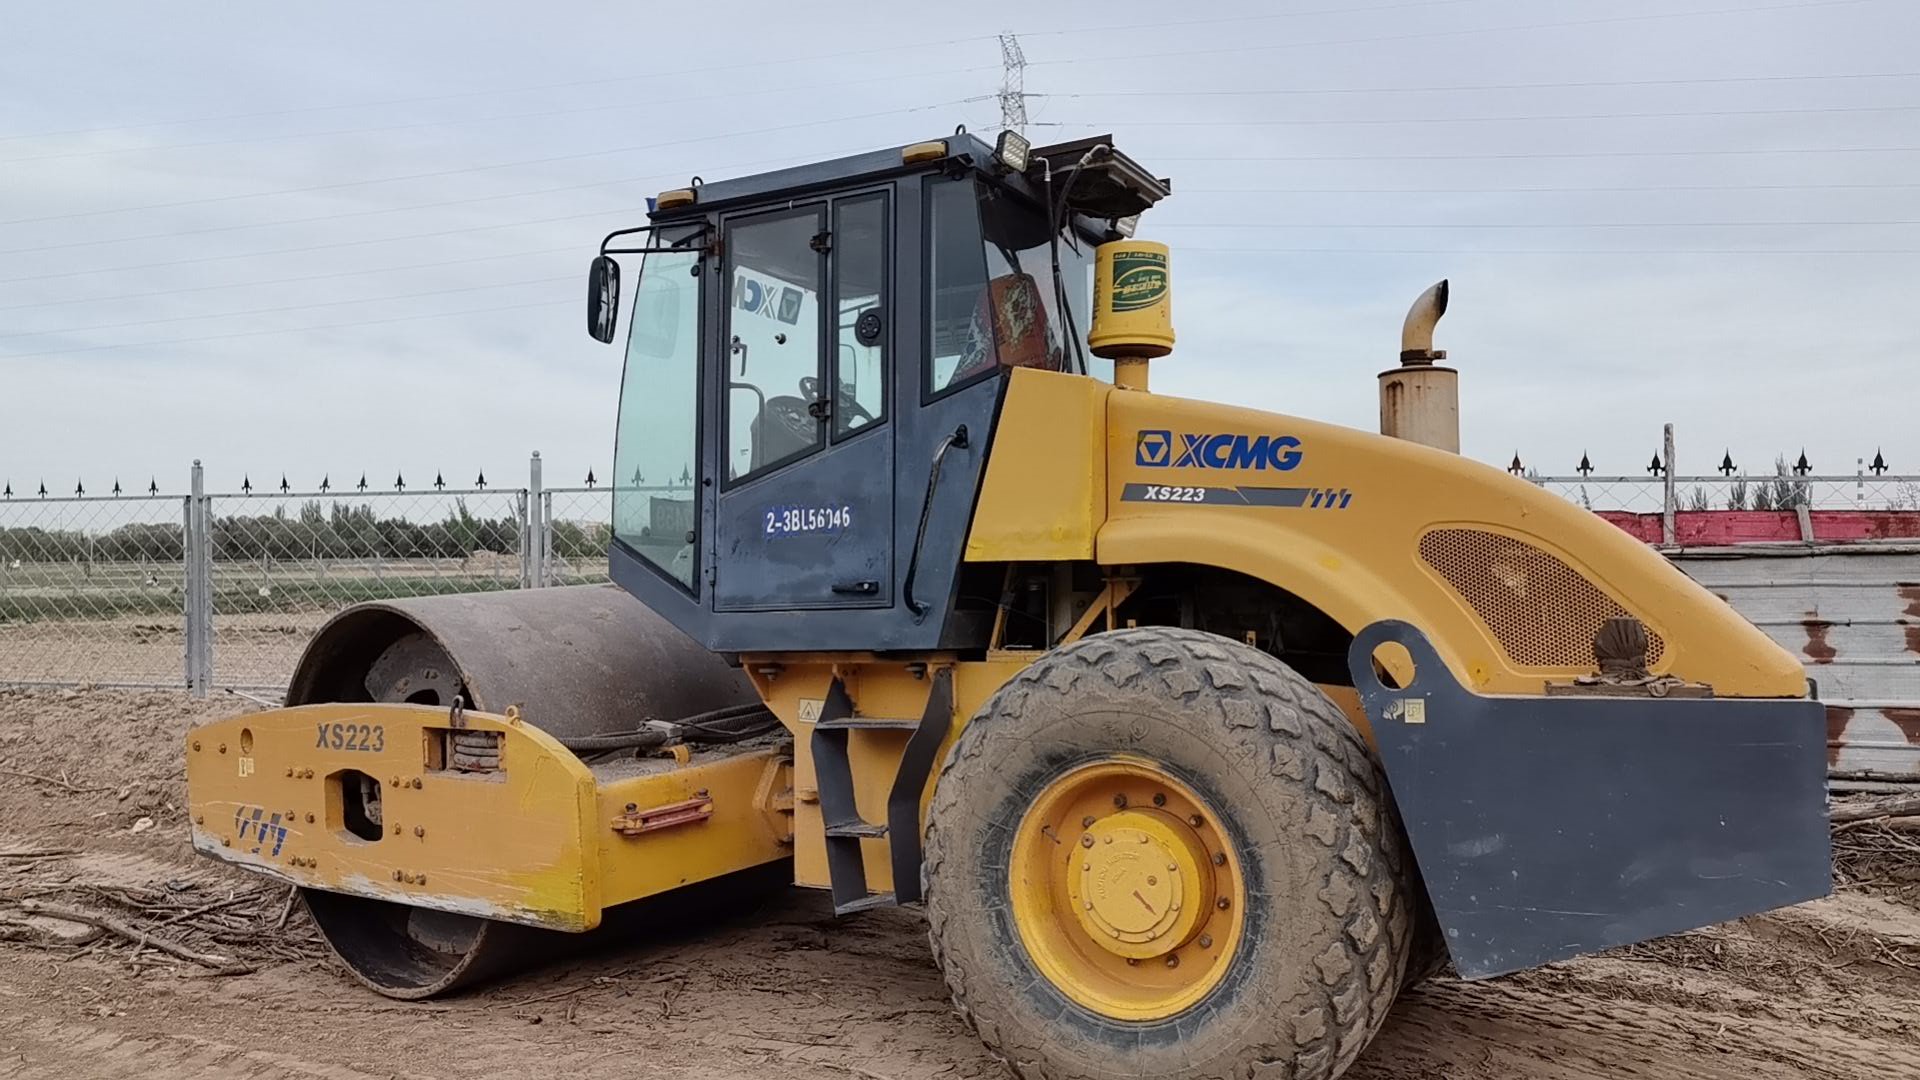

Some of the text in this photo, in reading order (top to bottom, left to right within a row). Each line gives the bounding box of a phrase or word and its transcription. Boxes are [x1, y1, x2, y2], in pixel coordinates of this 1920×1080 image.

[1171, 433, 1303, 471] XCMG
[1143, 485, 1206, 502] XS223
[316, 723, 385, 752] XS223
